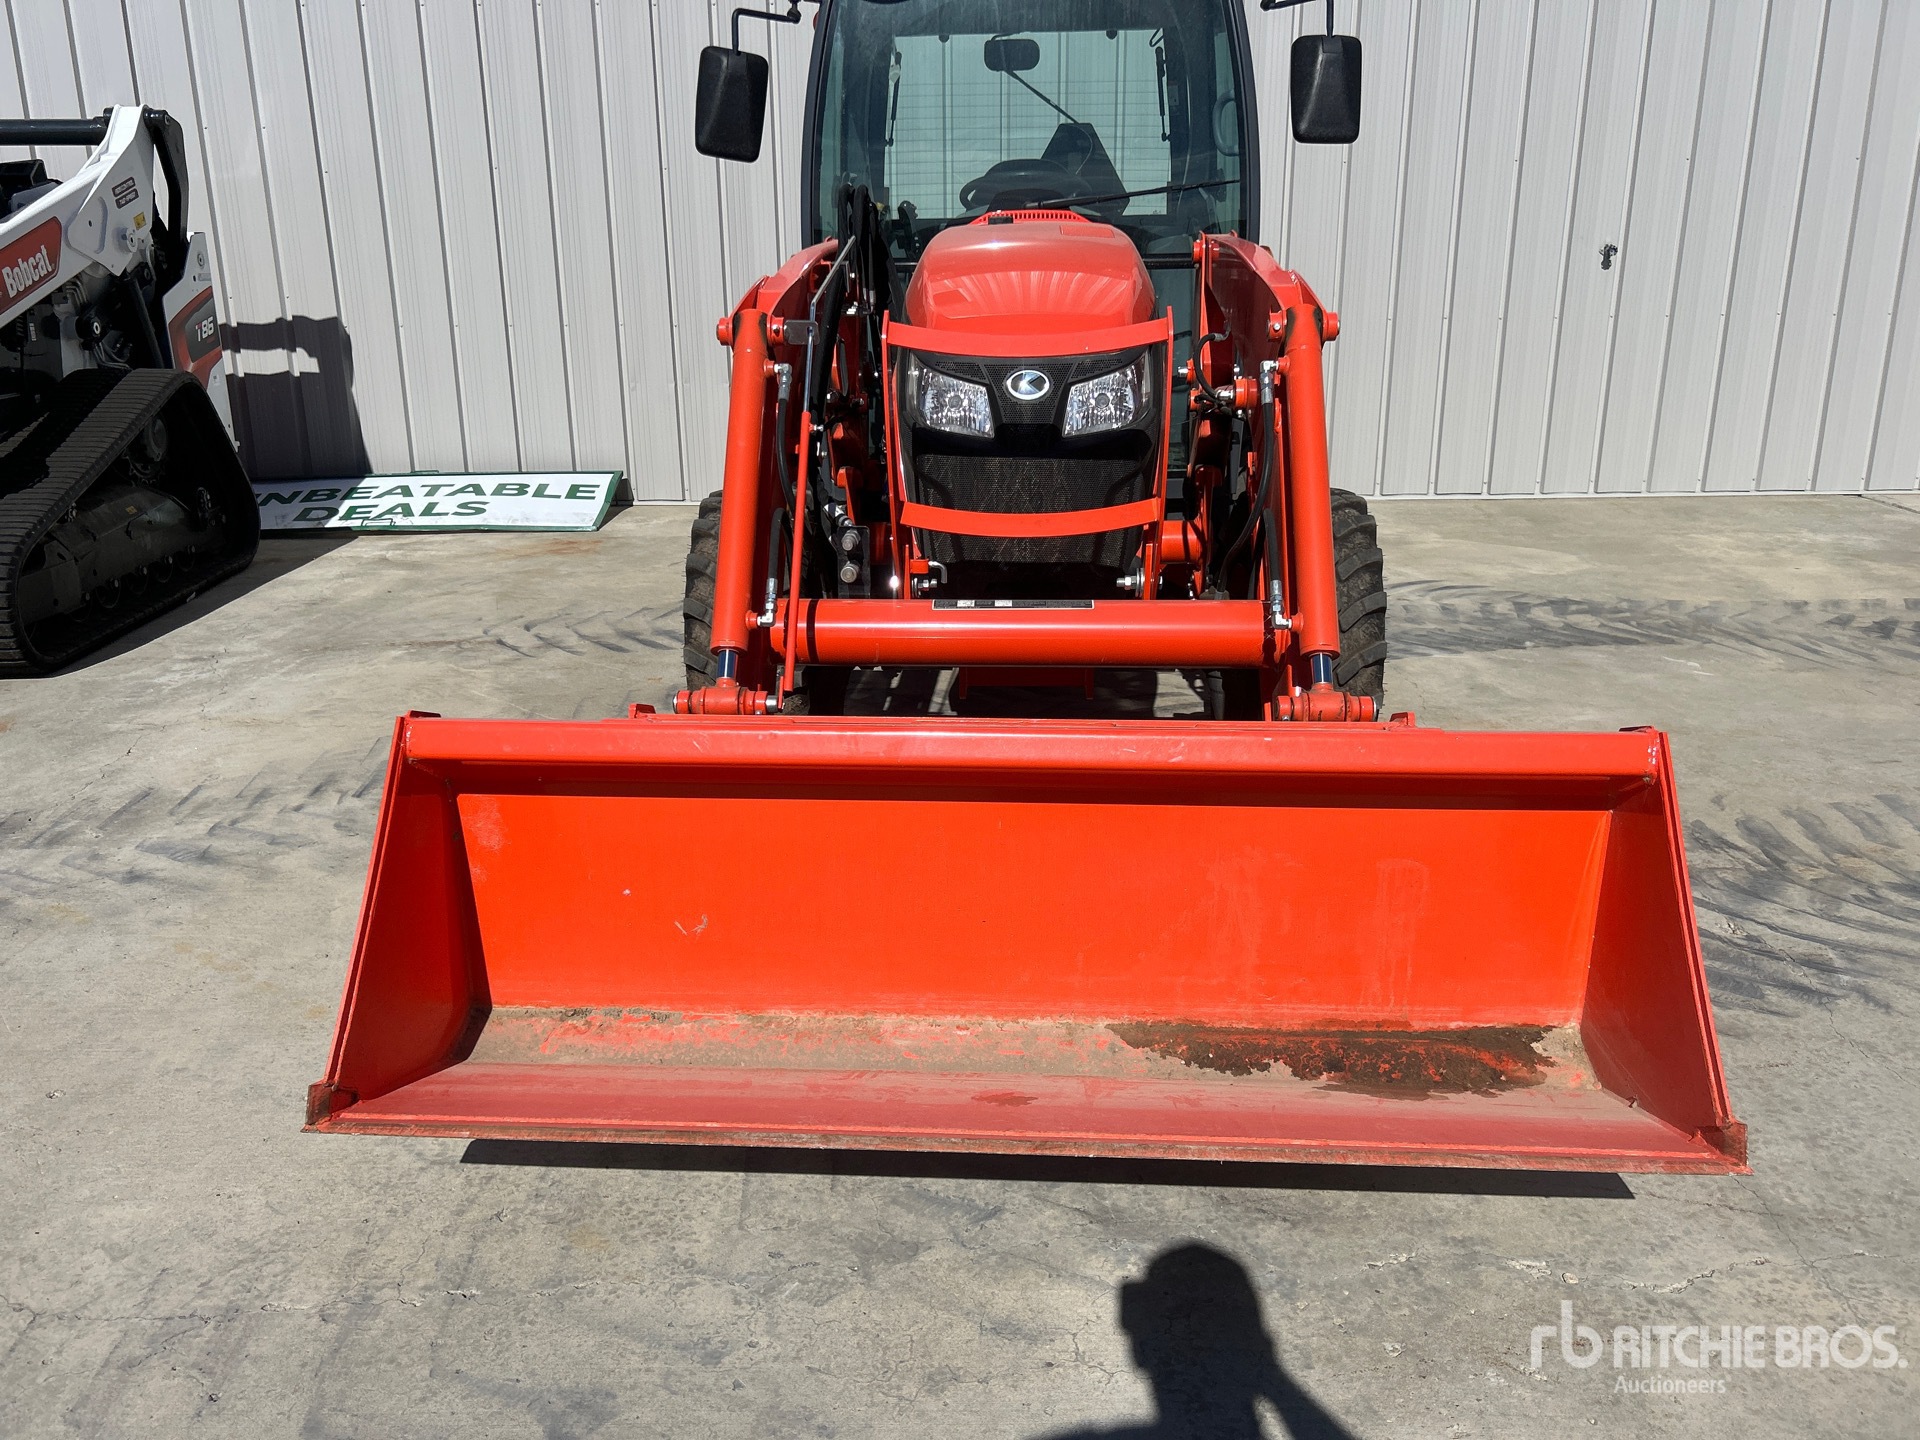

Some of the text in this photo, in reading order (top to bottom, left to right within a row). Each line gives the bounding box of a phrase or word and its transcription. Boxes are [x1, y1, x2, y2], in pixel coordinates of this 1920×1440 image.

[2, 245, 52, 298] Bobcat
[196, 316, 214, 341] T86
[255, 483, 601, 507] NBEATABLE
[293, 501, 490, 521] DEALS
